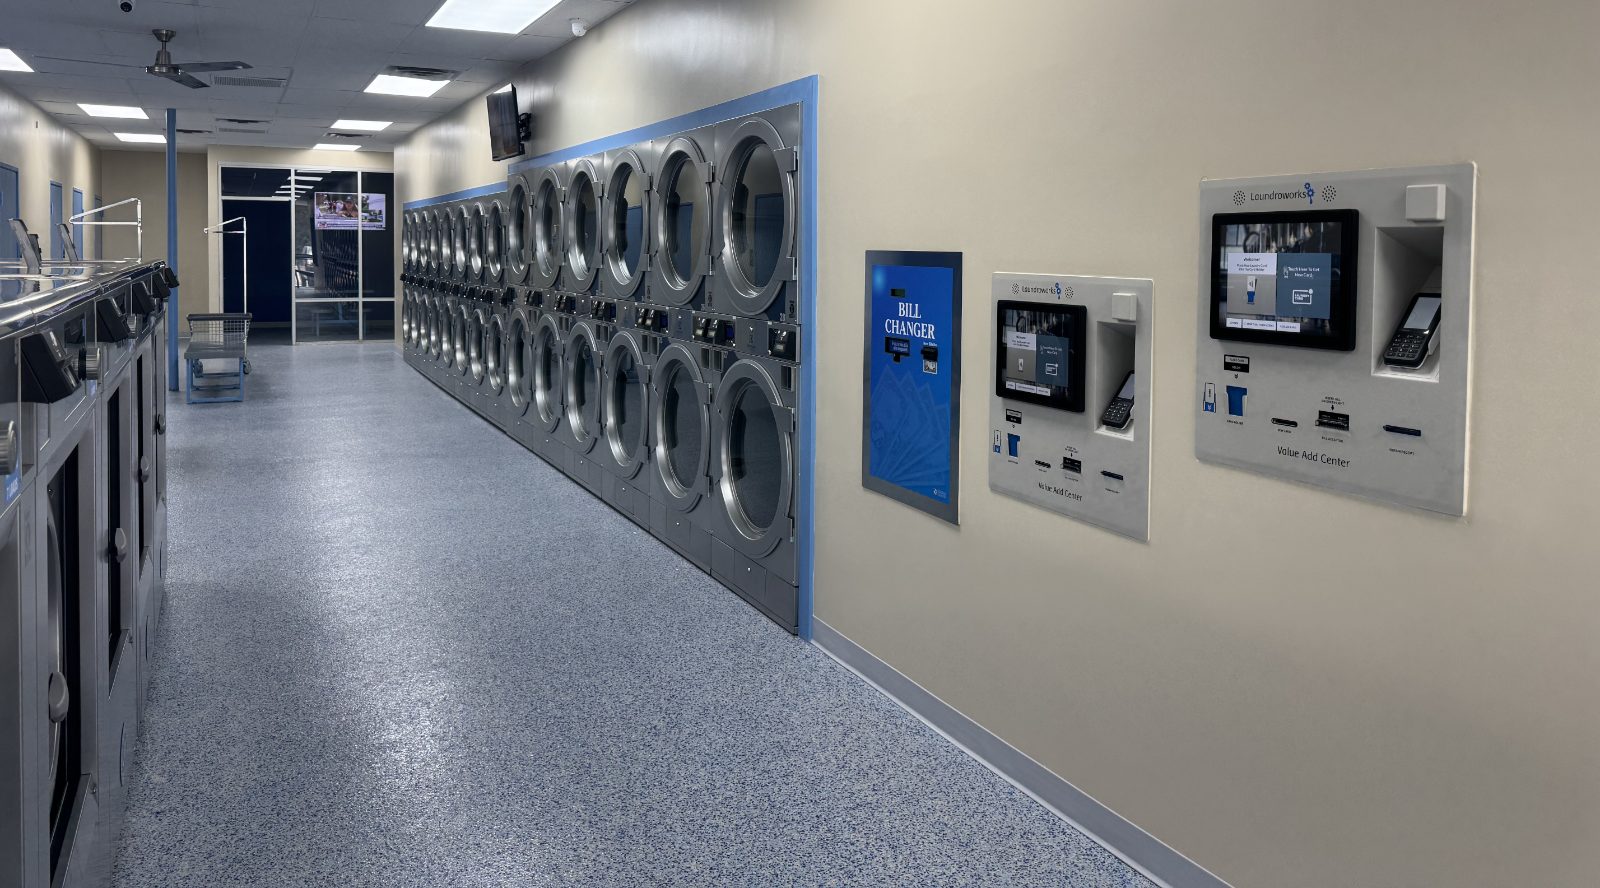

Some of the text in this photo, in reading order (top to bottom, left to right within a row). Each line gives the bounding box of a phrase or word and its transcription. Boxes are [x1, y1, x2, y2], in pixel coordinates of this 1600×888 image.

[1250, 190, 1307, 201] Laundroworks
[898, 301, 922, 319] BILL
[884, 318, 936, 340] CHANGER
[1277, 445, 1351, 467] Value Add Center
